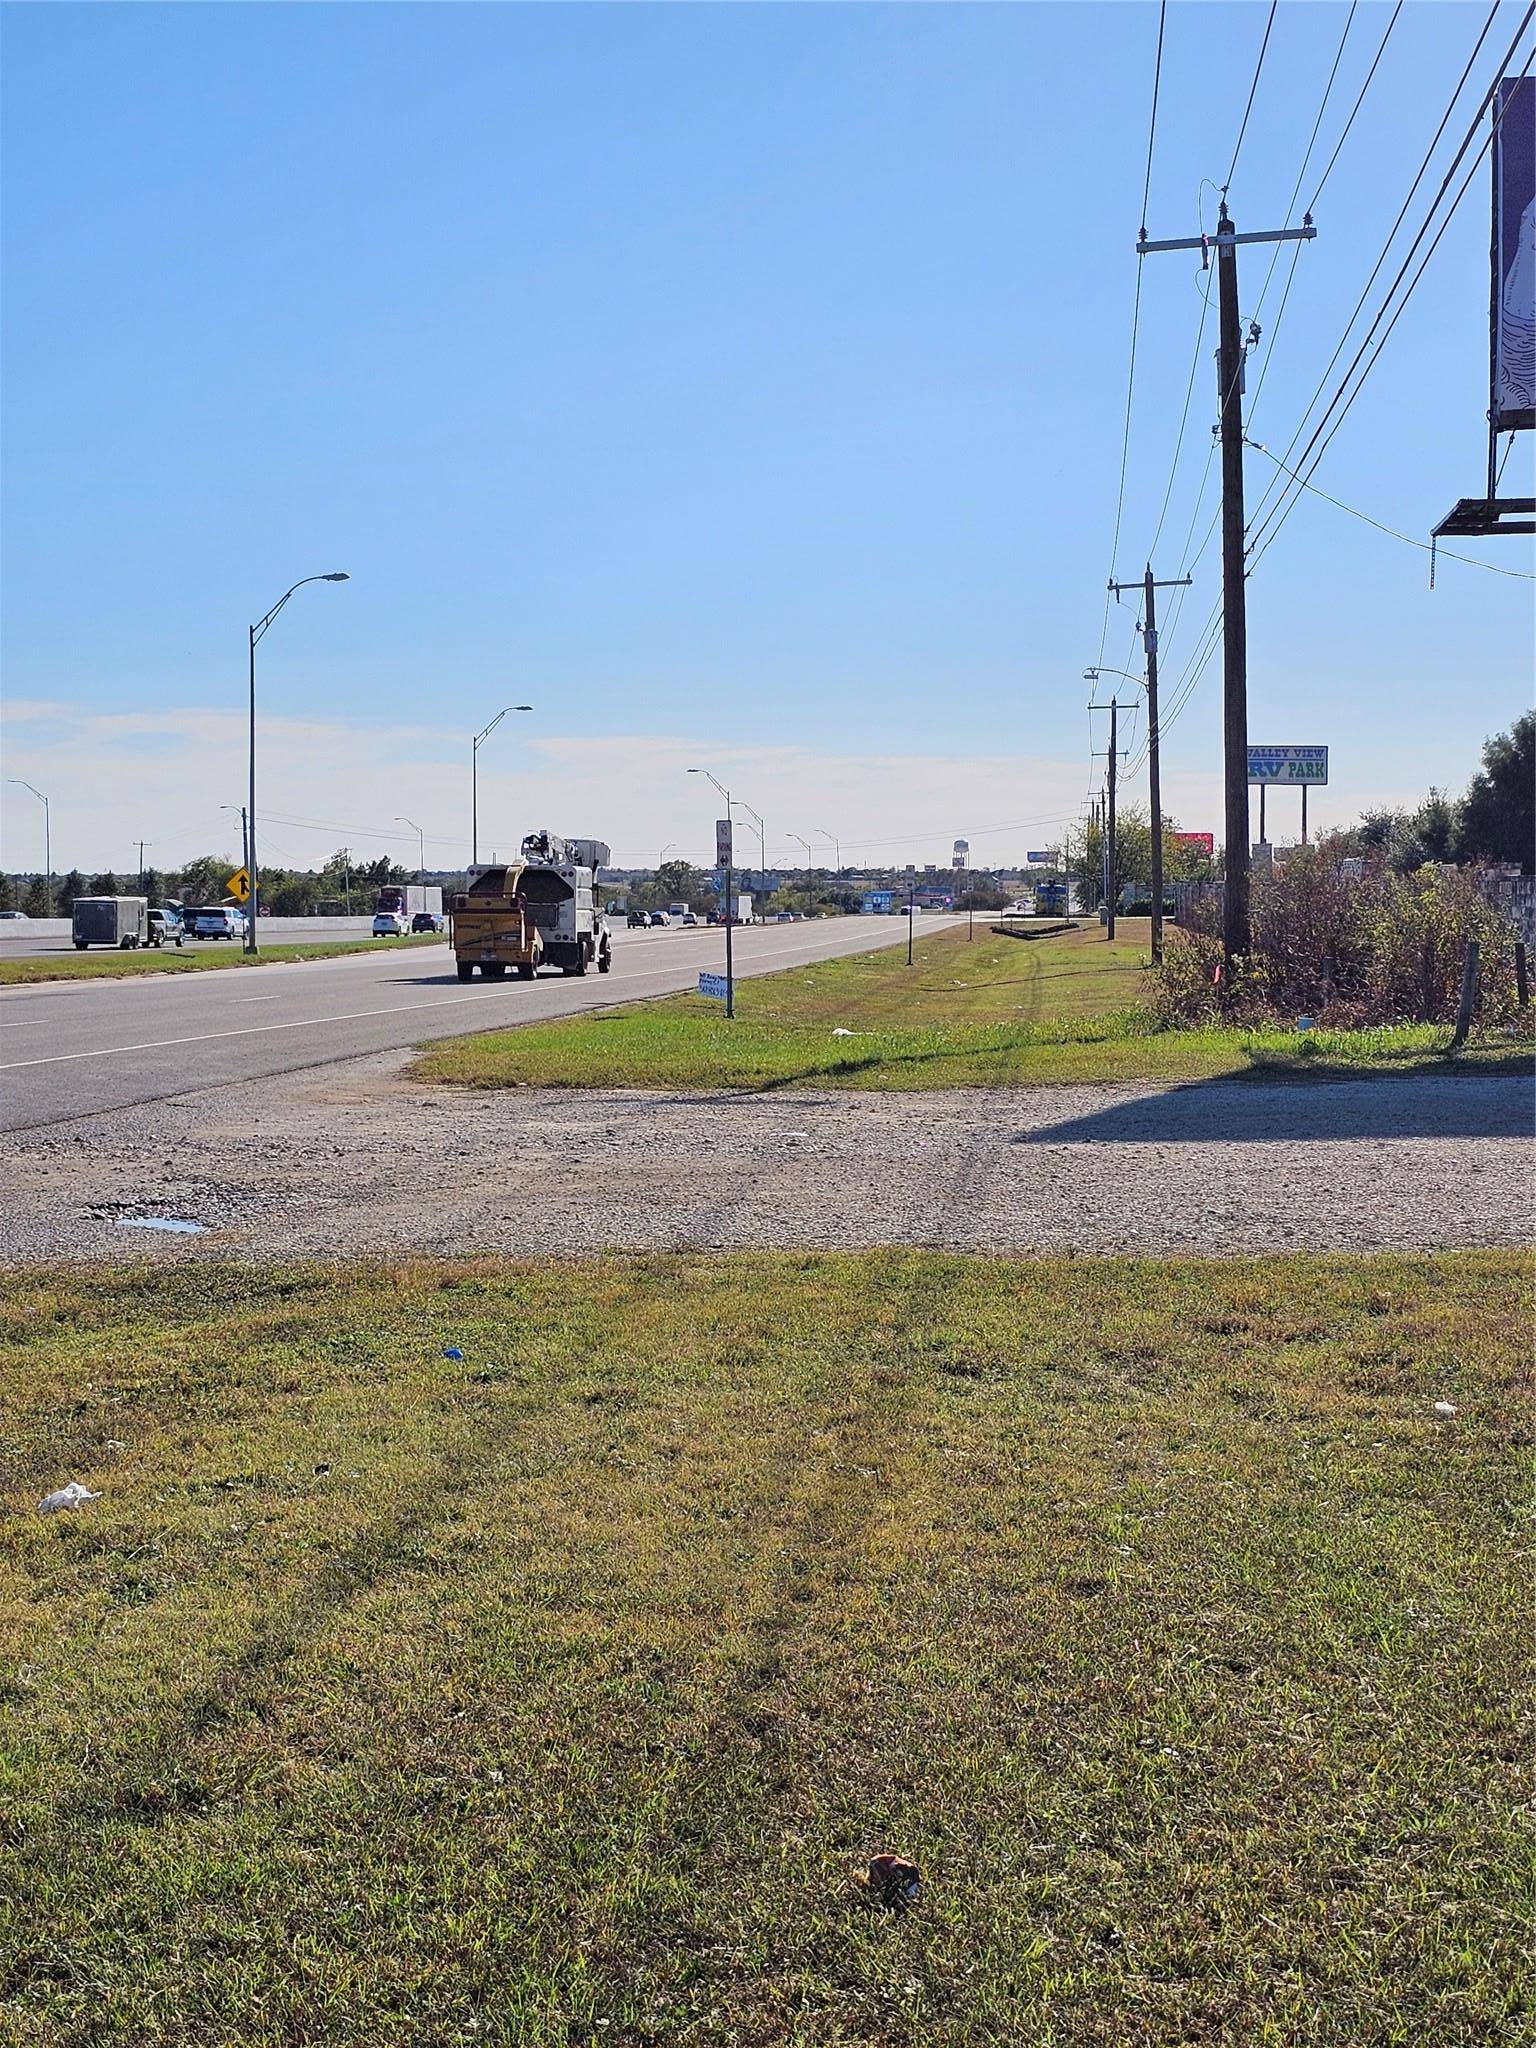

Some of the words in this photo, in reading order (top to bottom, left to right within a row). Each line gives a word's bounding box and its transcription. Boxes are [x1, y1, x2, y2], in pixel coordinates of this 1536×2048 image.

[1294, 748, 1325, 758] VIEW
[1247, 761, 1284, 777] RV
[1288, 761, 1325, 778] PARK
